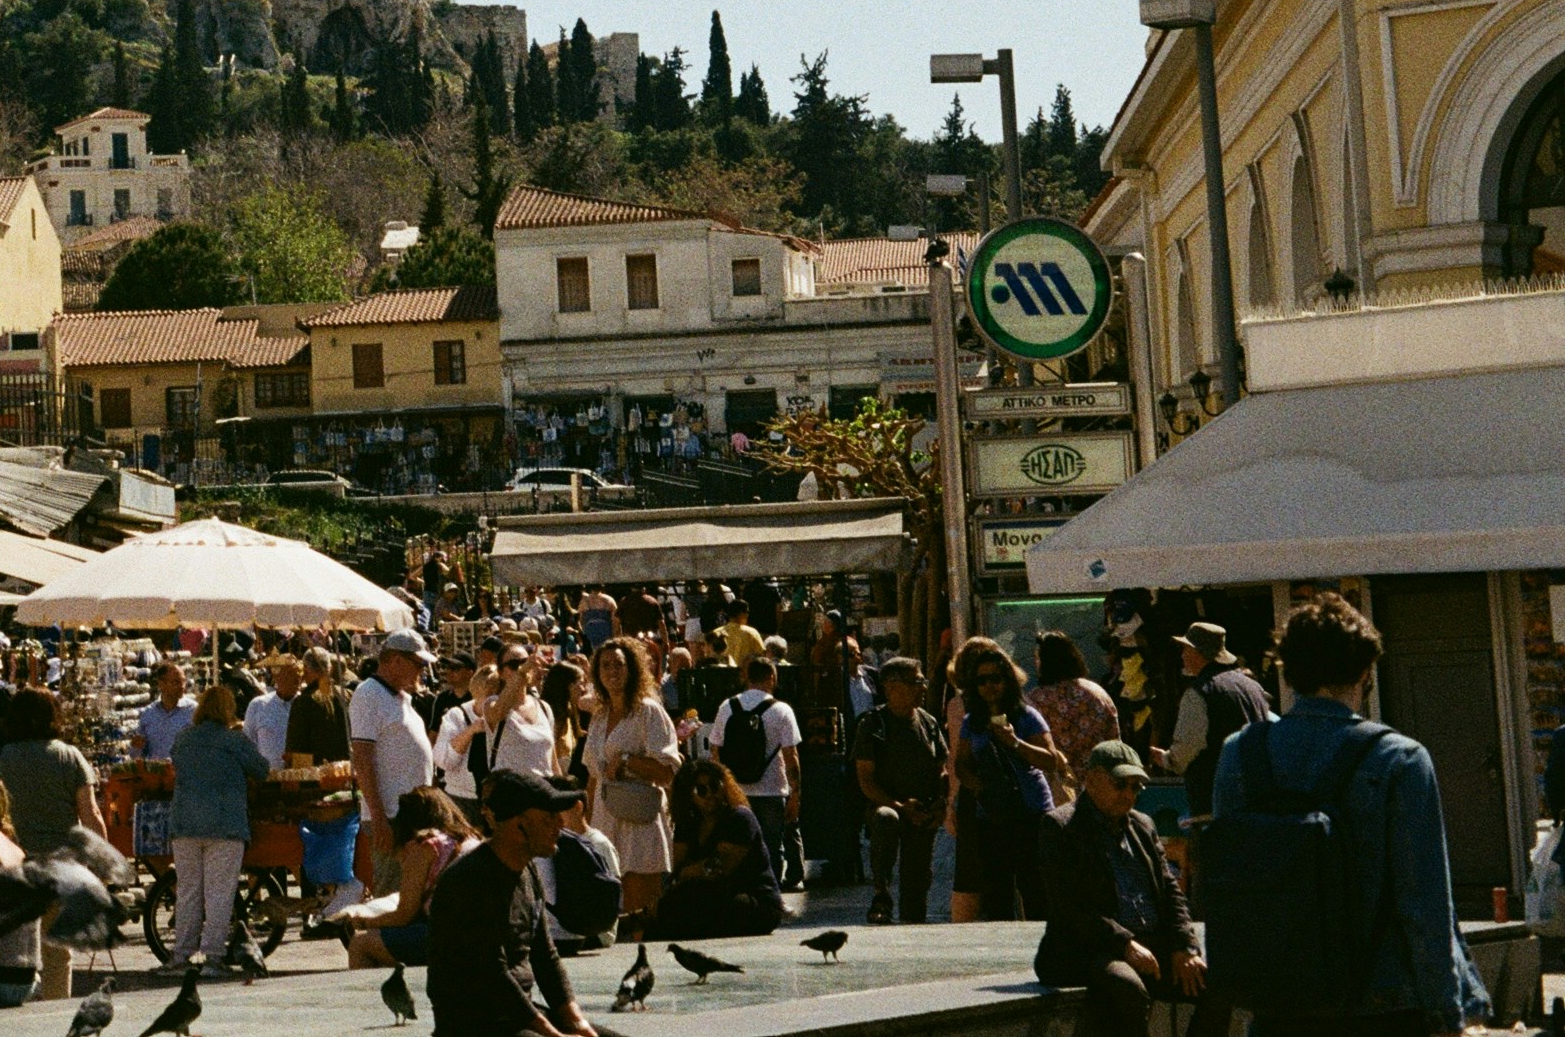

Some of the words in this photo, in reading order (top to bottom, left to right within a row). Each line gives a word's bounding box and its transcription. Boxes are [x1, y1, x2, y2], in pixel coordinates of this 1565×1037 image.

[1002, 396, 1046, 409] ΑΤΤΙΚΟ
[1051, 394, 1096, 407] ΜΕΤΡΟ
[1030, 449, 1076, 479] ΗΣΑΠ
